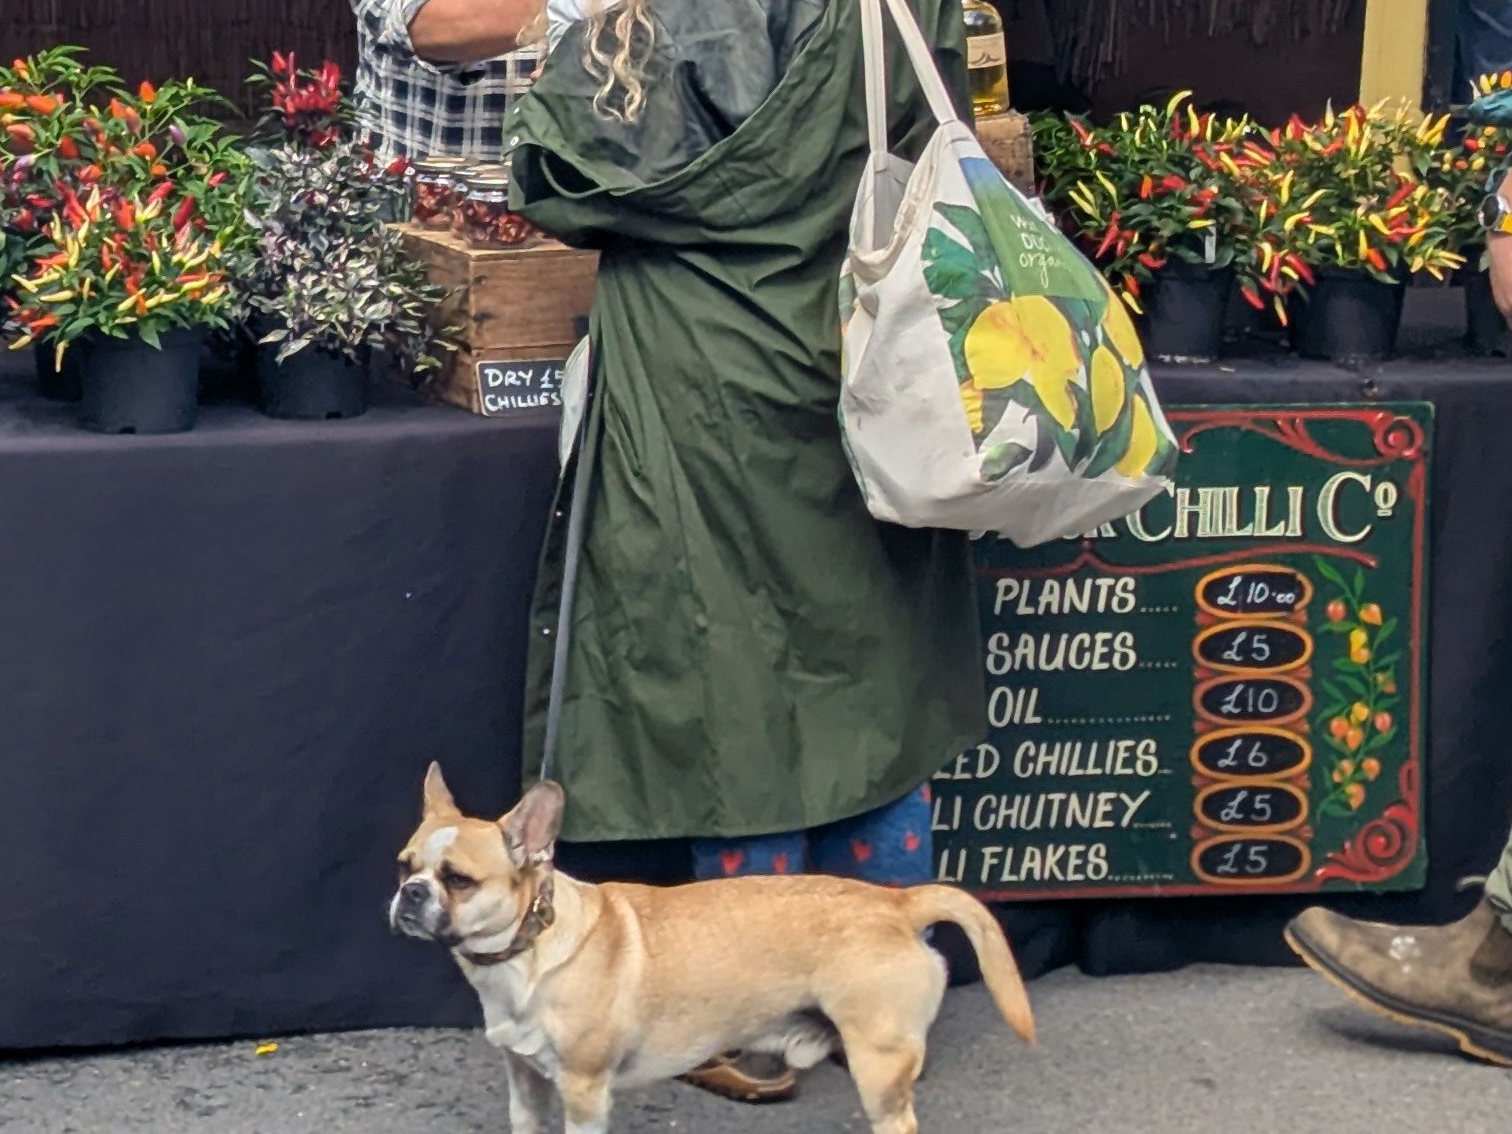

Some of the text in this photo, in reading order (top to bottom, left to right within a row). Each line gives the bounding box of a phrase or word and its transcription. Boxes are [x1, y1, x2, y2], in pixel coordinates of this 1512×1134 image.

[484, 368, 533, 387] DRY
[484, 391, 562, 412] CHILLIES
[1125, 479, 1303, 543] CHILLI
[994, 576, 1137, 617] PLANTS
[986, 632, 1271, 675] SAUCES £5
[988, 686, 1279, 727] OIL £10
[933, 738, 1269, 781] ED CHILLIES £6
[973, 789, 1151, 832] CHUTNEY
[1220, 793, 1273, 822] £5
[981, 843, 1109, 883] FLAKES
[1217, 846, 1269, 874] £5
